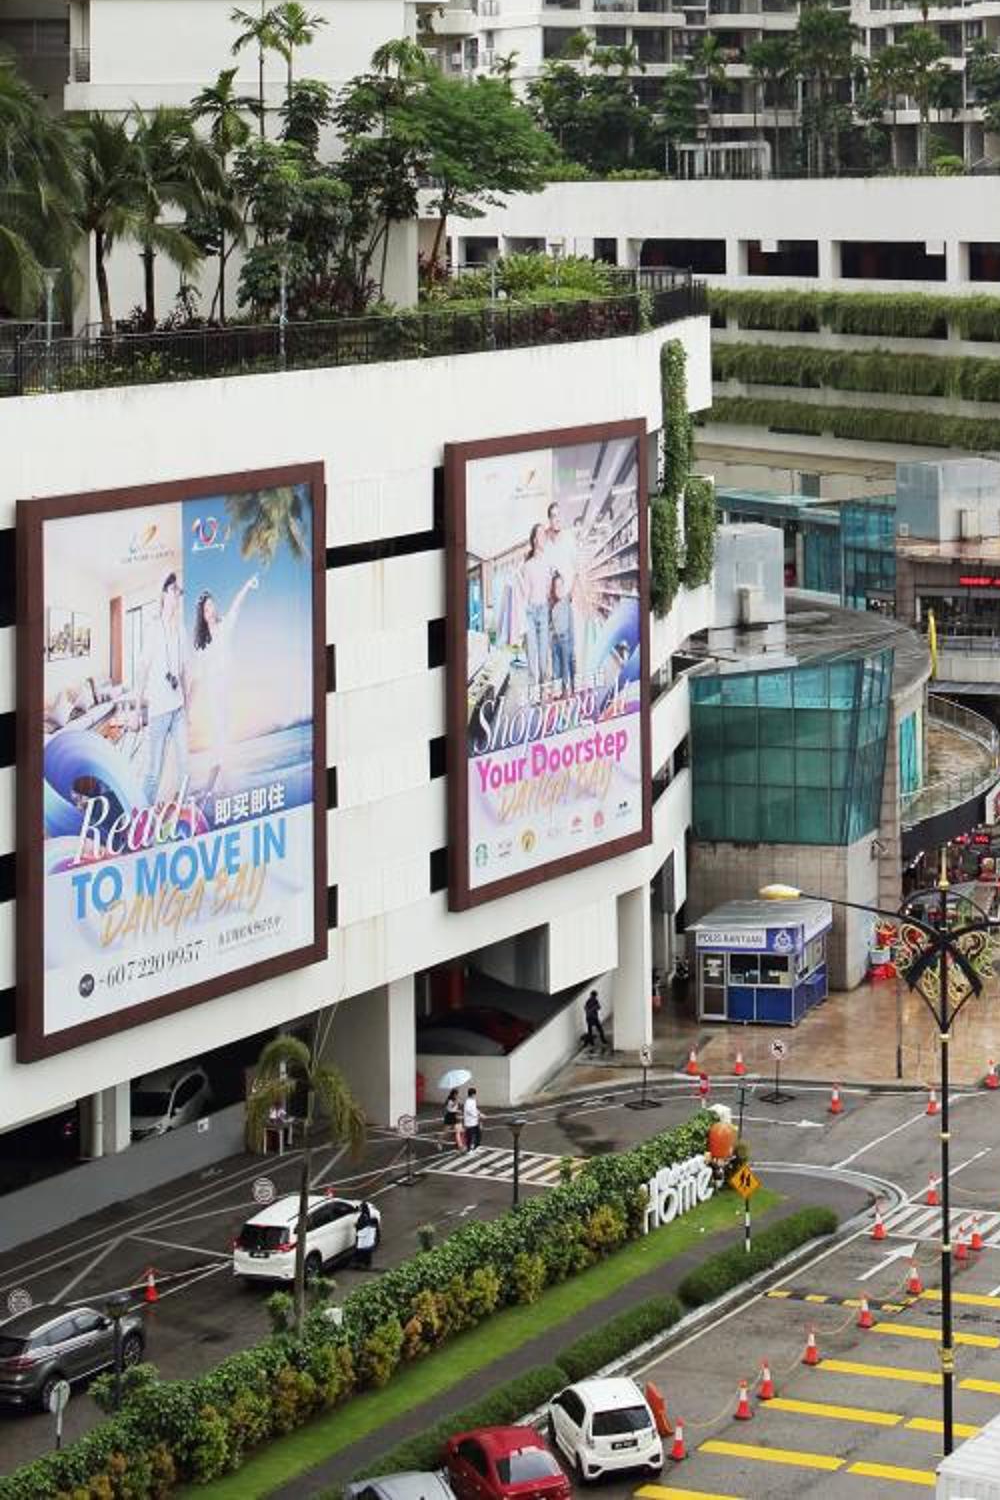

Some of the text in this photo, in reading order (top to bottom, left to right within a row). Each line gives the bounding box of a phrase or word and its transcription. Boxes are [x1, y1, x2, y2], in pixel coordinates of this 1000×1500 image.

[476, 728, 629, 794] Your Doorstep
[214, 784, 285, 825] 即买即住
[71, 818, 287, 920] TO MOVE IN
